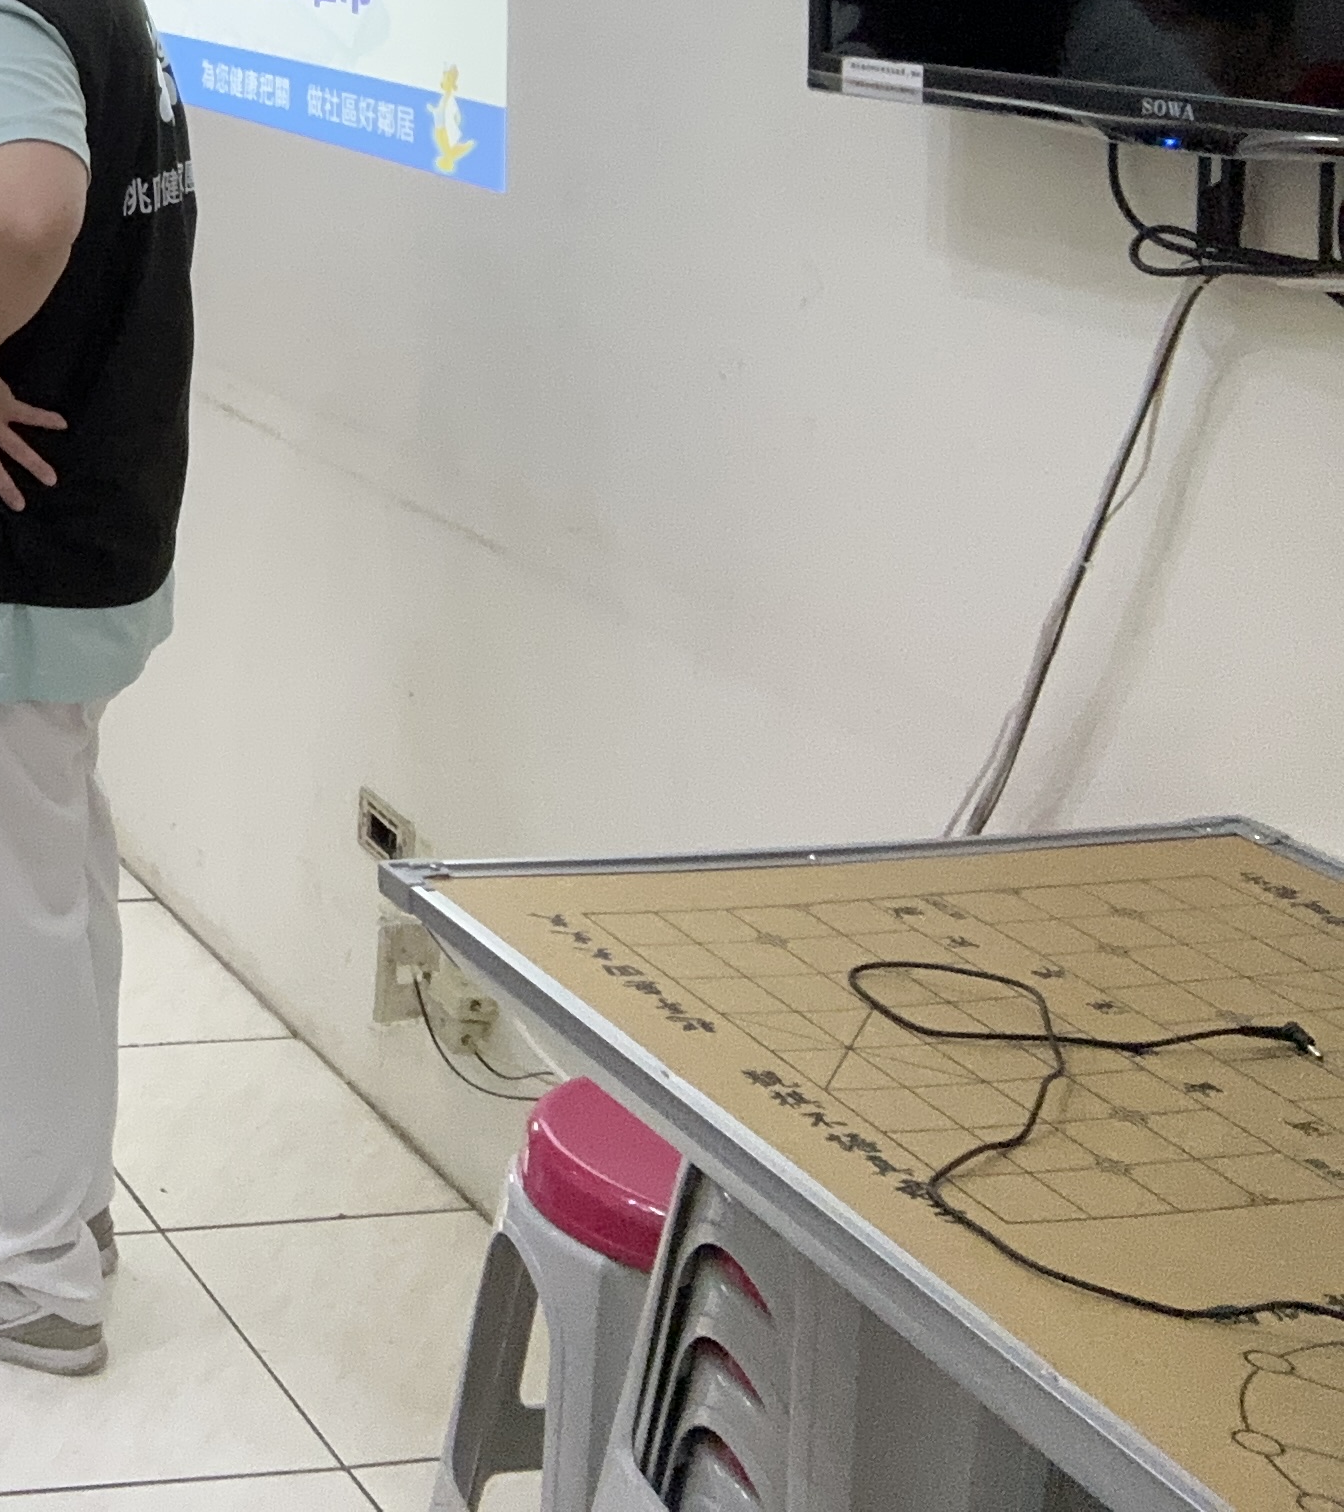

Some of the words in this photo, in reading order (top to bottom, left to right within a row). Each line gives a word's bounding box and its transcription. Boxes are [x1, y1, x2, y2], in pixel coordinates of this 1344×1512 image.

[201, 58, 291, 111] 為您健康把關
[306, 83, 416, 144] 做社區好鄰居
[1141, 97, 1195, 121] SOWA
